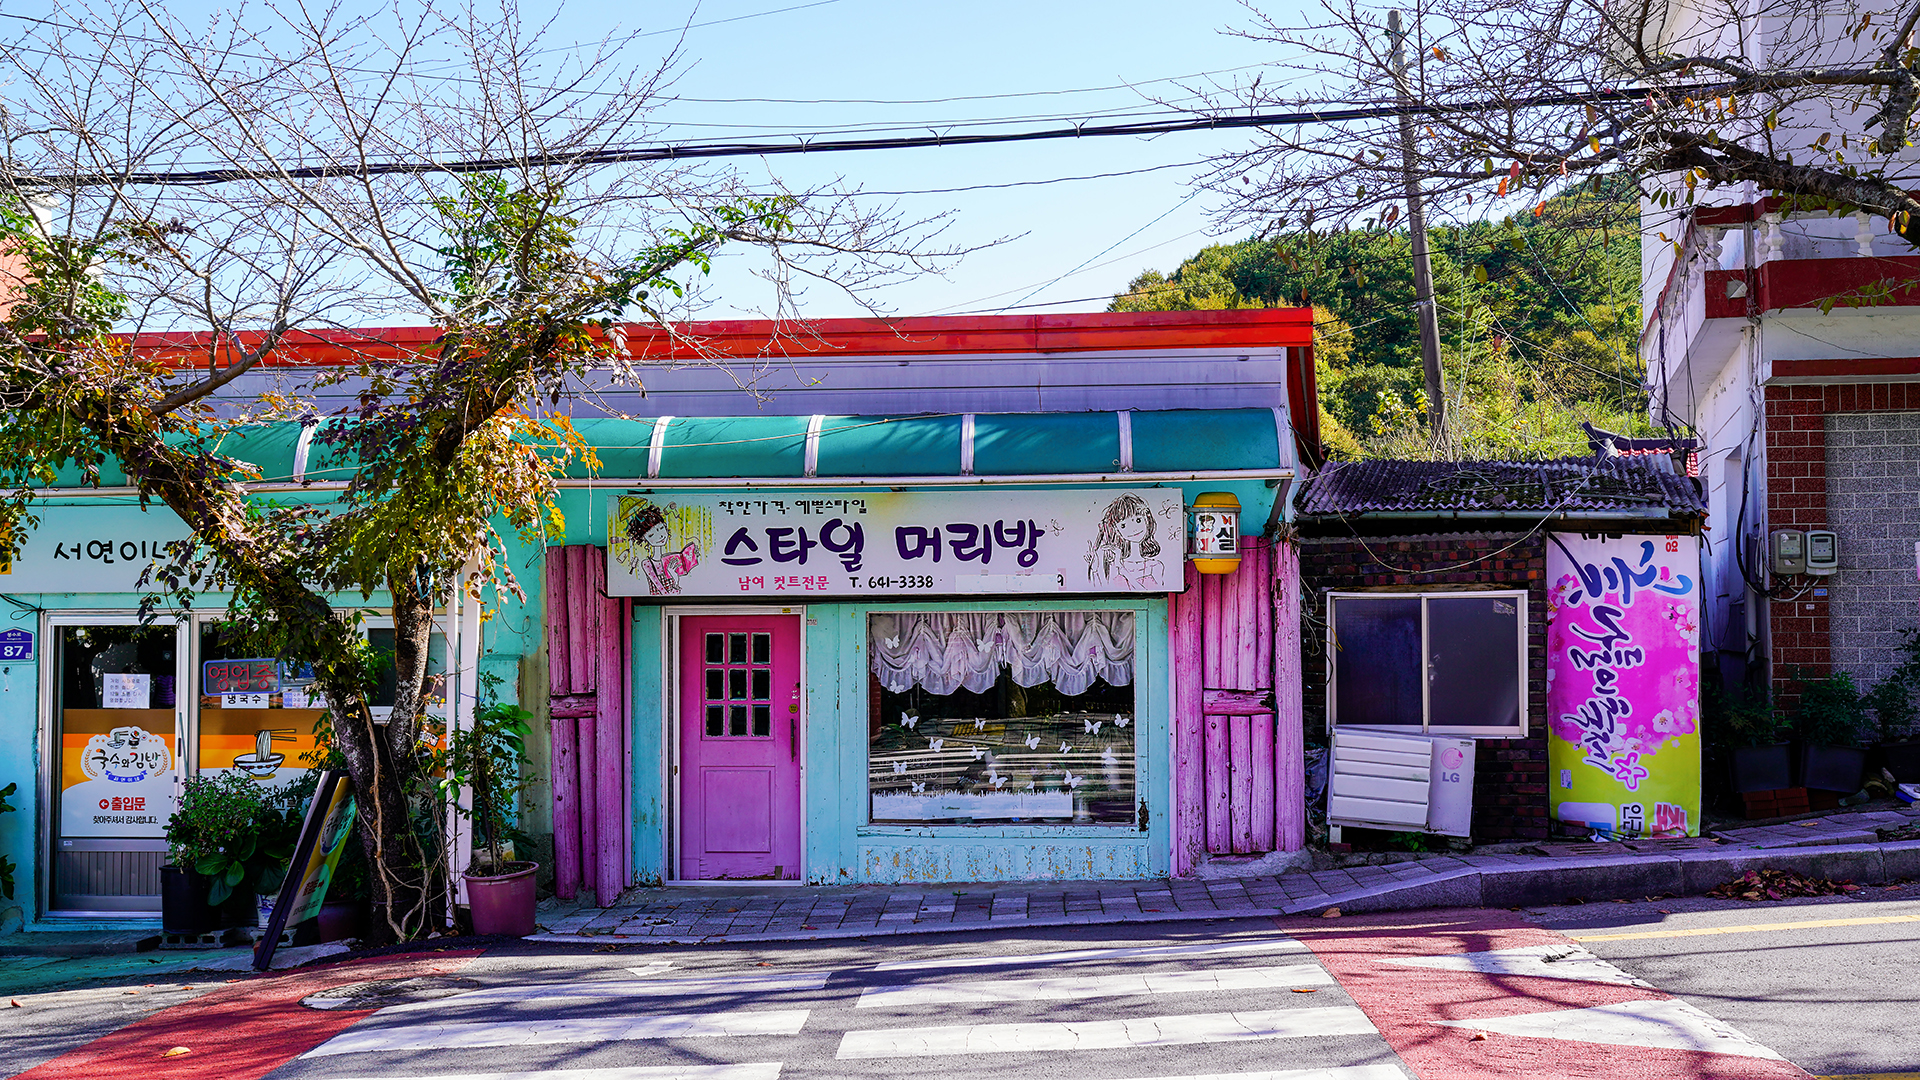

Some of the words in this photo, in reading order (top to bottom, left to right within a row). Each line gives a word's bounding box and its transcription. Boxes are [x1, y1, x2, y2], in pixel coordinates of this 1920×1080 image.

[794, 499, 867, 515] 예쁜스타일
[720, 518, 865, 573] 스타일
[895, 519, 1046, 567] 머리방
[738, 576, 764, 591] 남여
[774, 576, 830, 591] 컷트전문
[849, 576, 863, 588] T.
[868, 575, 934, 589] 641-3338
[4, 645, 24, 657] 87
[208, 664, 276, 691] 영업중
[227, 694, 261, 705] 냉국수
[1442, 772, 1460, 783] LG
[111, 796, 146, 811] 출입문
[93, 815, 125, 824] 찾아주셔서
[125, 815, 159, 824] 감사합니다.
